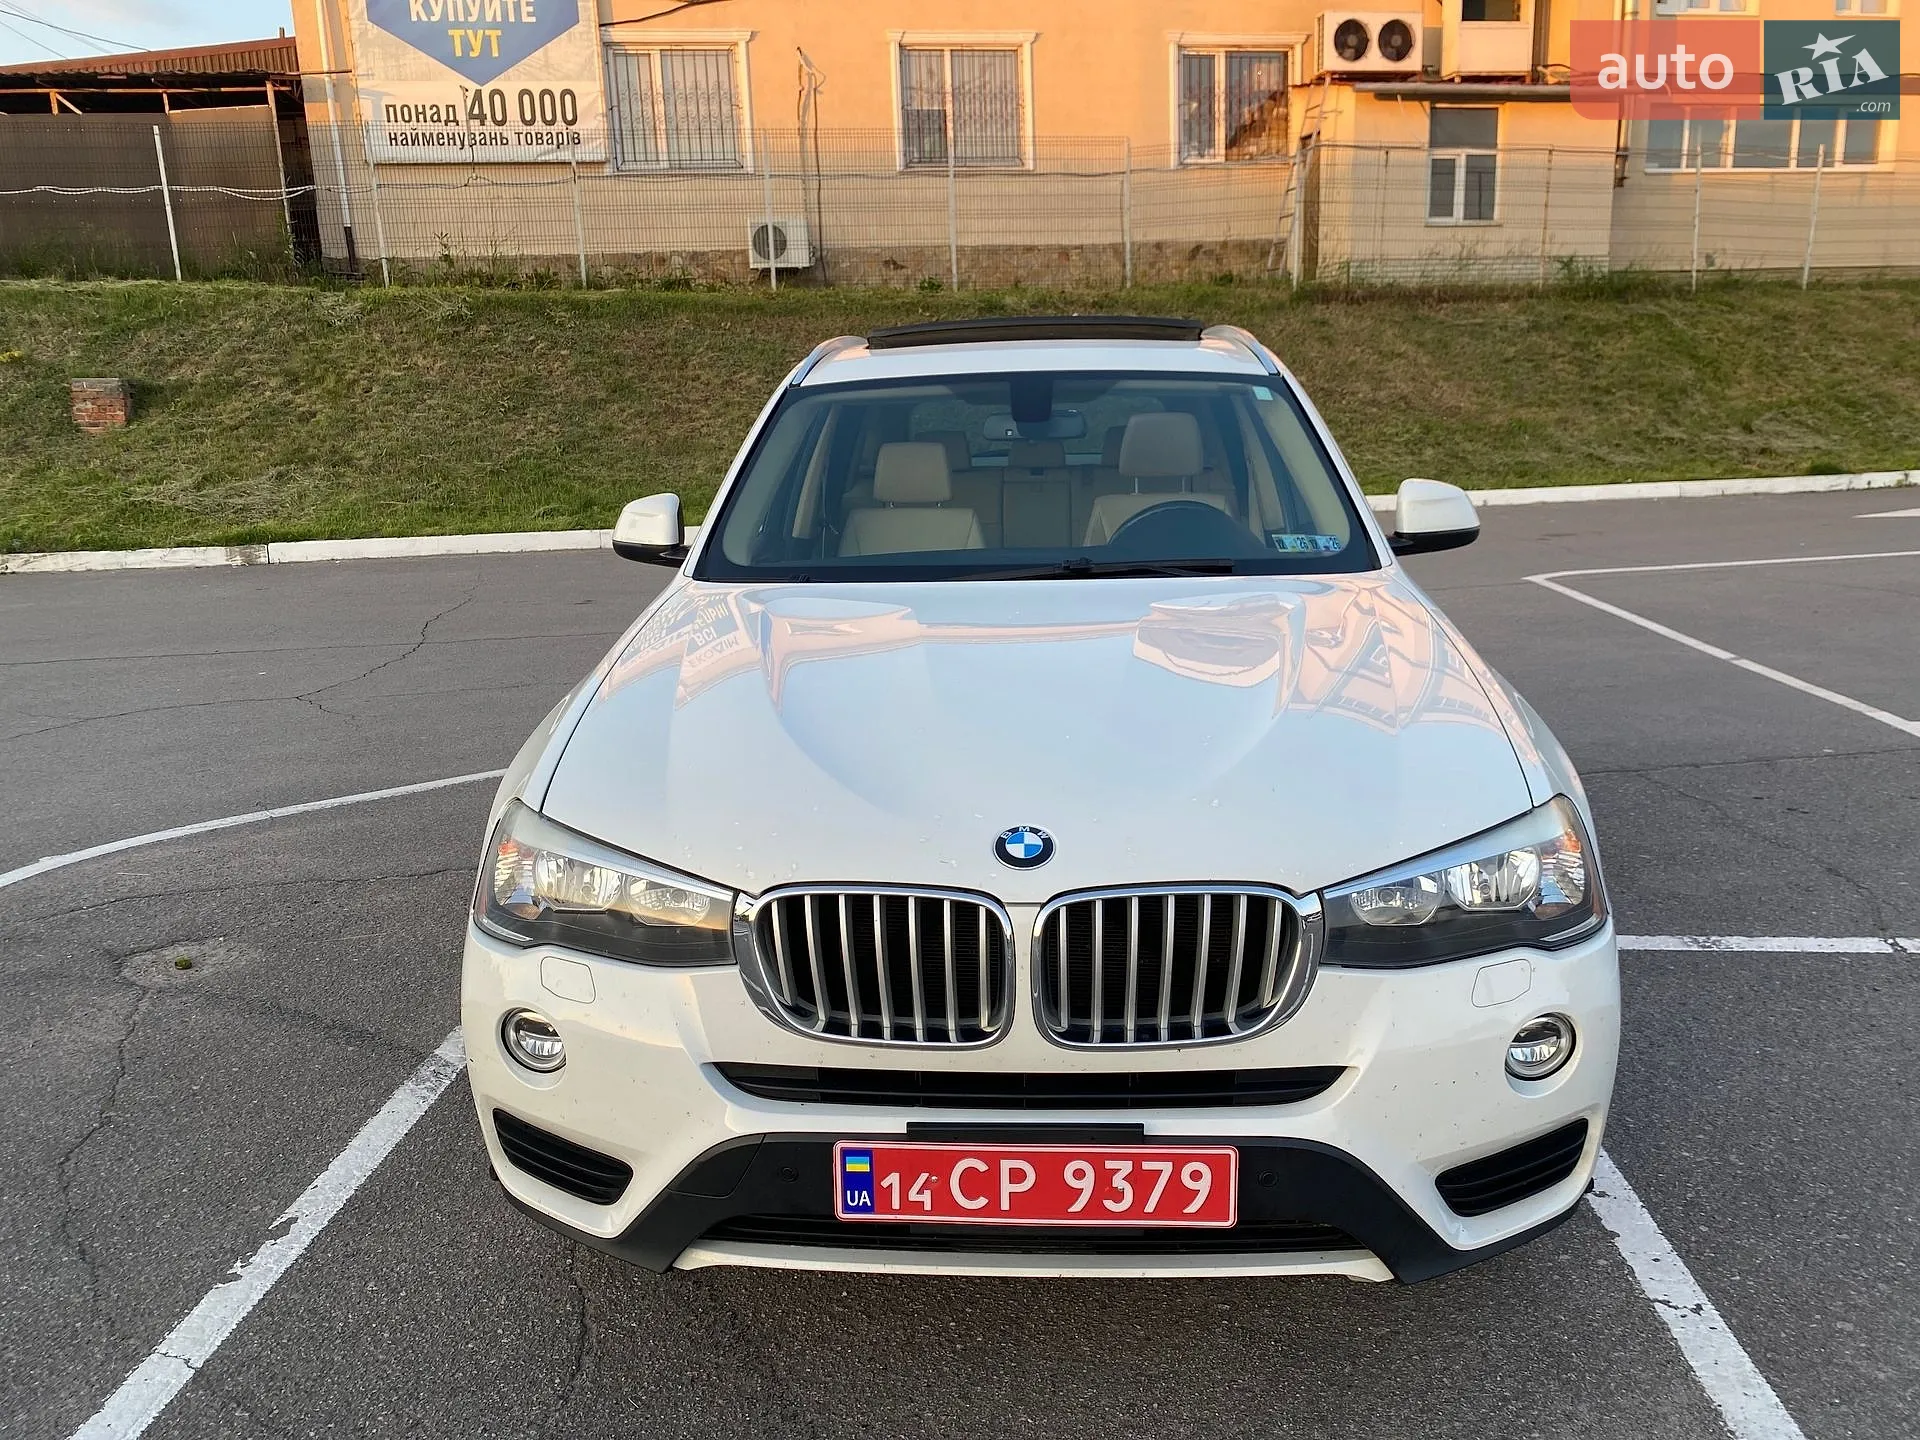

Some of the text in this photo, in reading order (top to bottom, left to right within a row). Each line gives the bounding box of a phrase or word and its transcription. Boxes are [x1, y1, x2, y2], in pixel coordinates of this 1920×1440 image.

[448, 29, 502, 58] ТУТ
[385, 88, 578, 127] понад 40 000
[388, 127, 582, 150] найменувань товарів
[1000, 826, 1049, 839] BMW
[846, 1190, 872, 1207] UA
[880, 1157, 1213, 1214] 14 CP 9379
